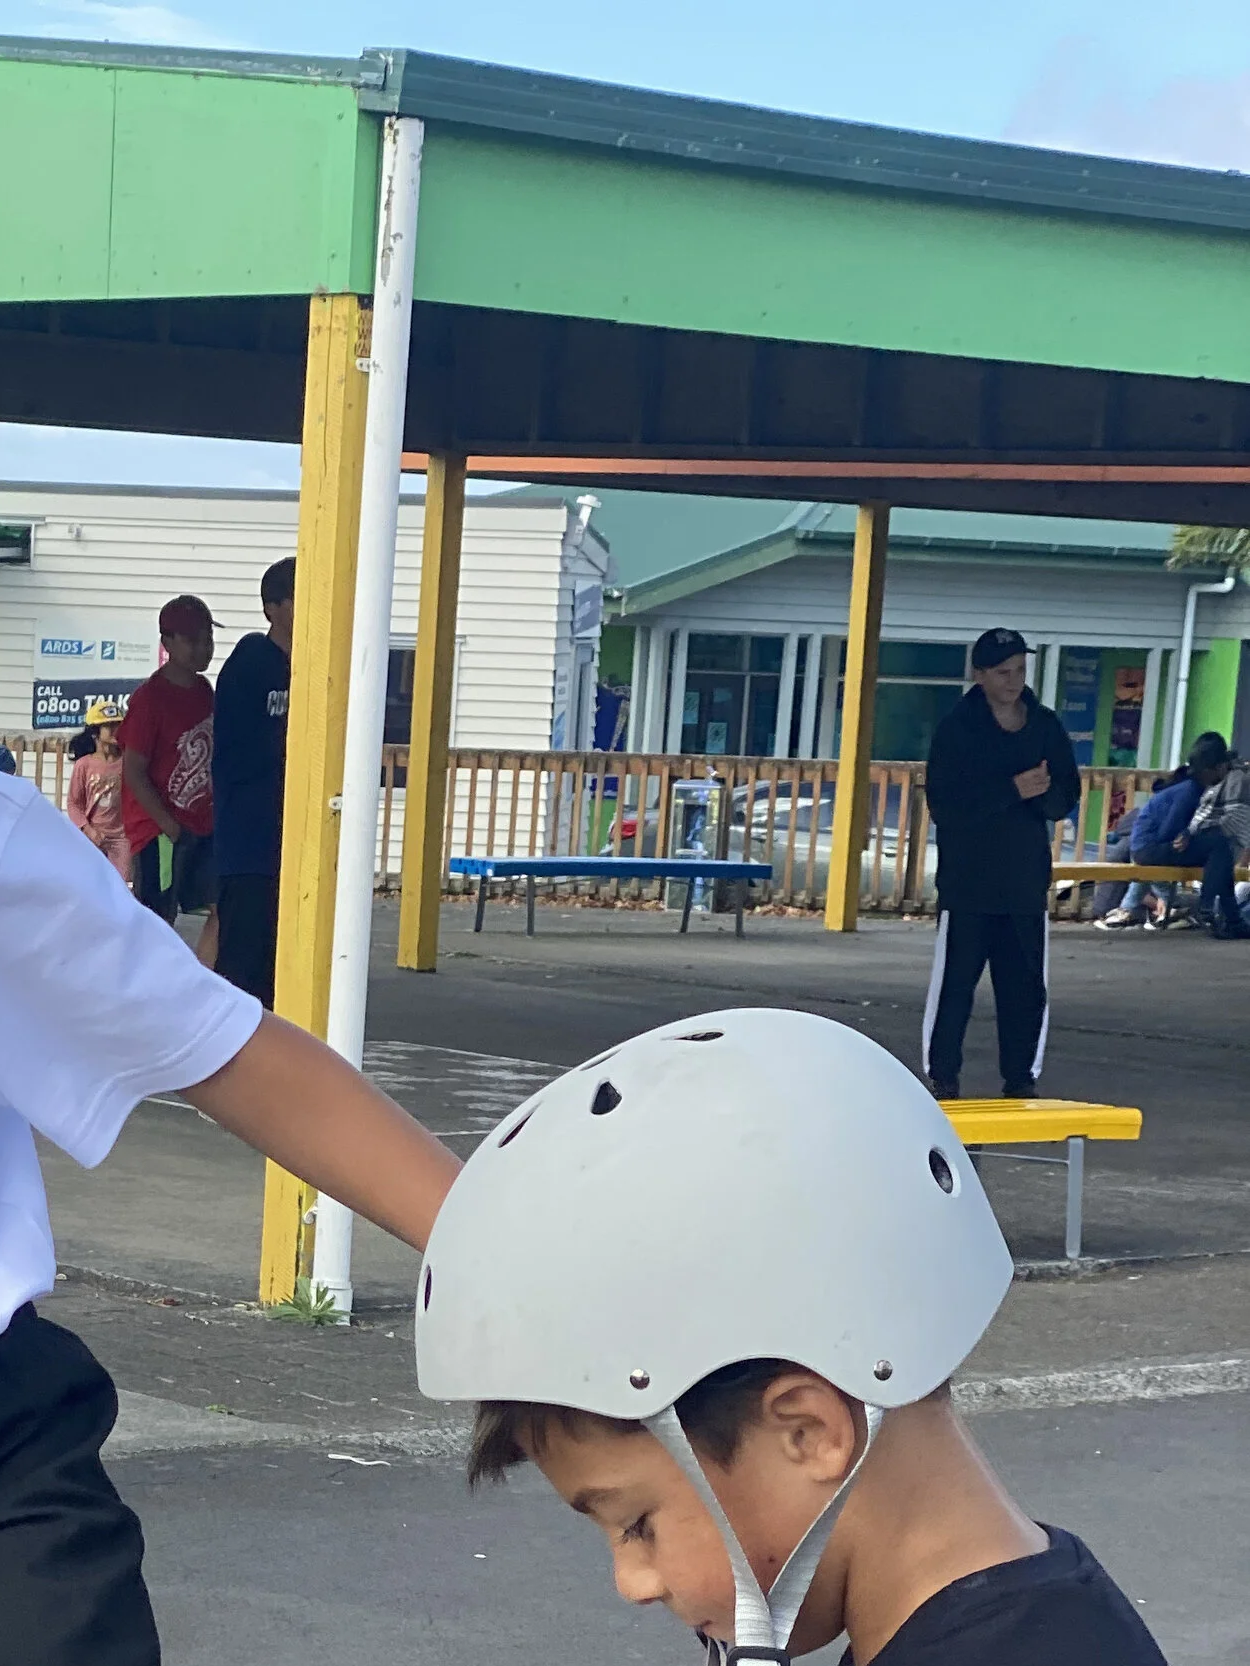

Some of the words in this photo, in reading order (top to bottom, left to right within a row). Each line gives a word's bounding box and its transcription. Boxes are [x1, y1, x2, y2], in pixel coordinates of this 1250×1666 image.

[43, 640, 80, 653] ARDS
[37, 685, 63, 697] CALL
[36, 697, 81, 713] 0800
